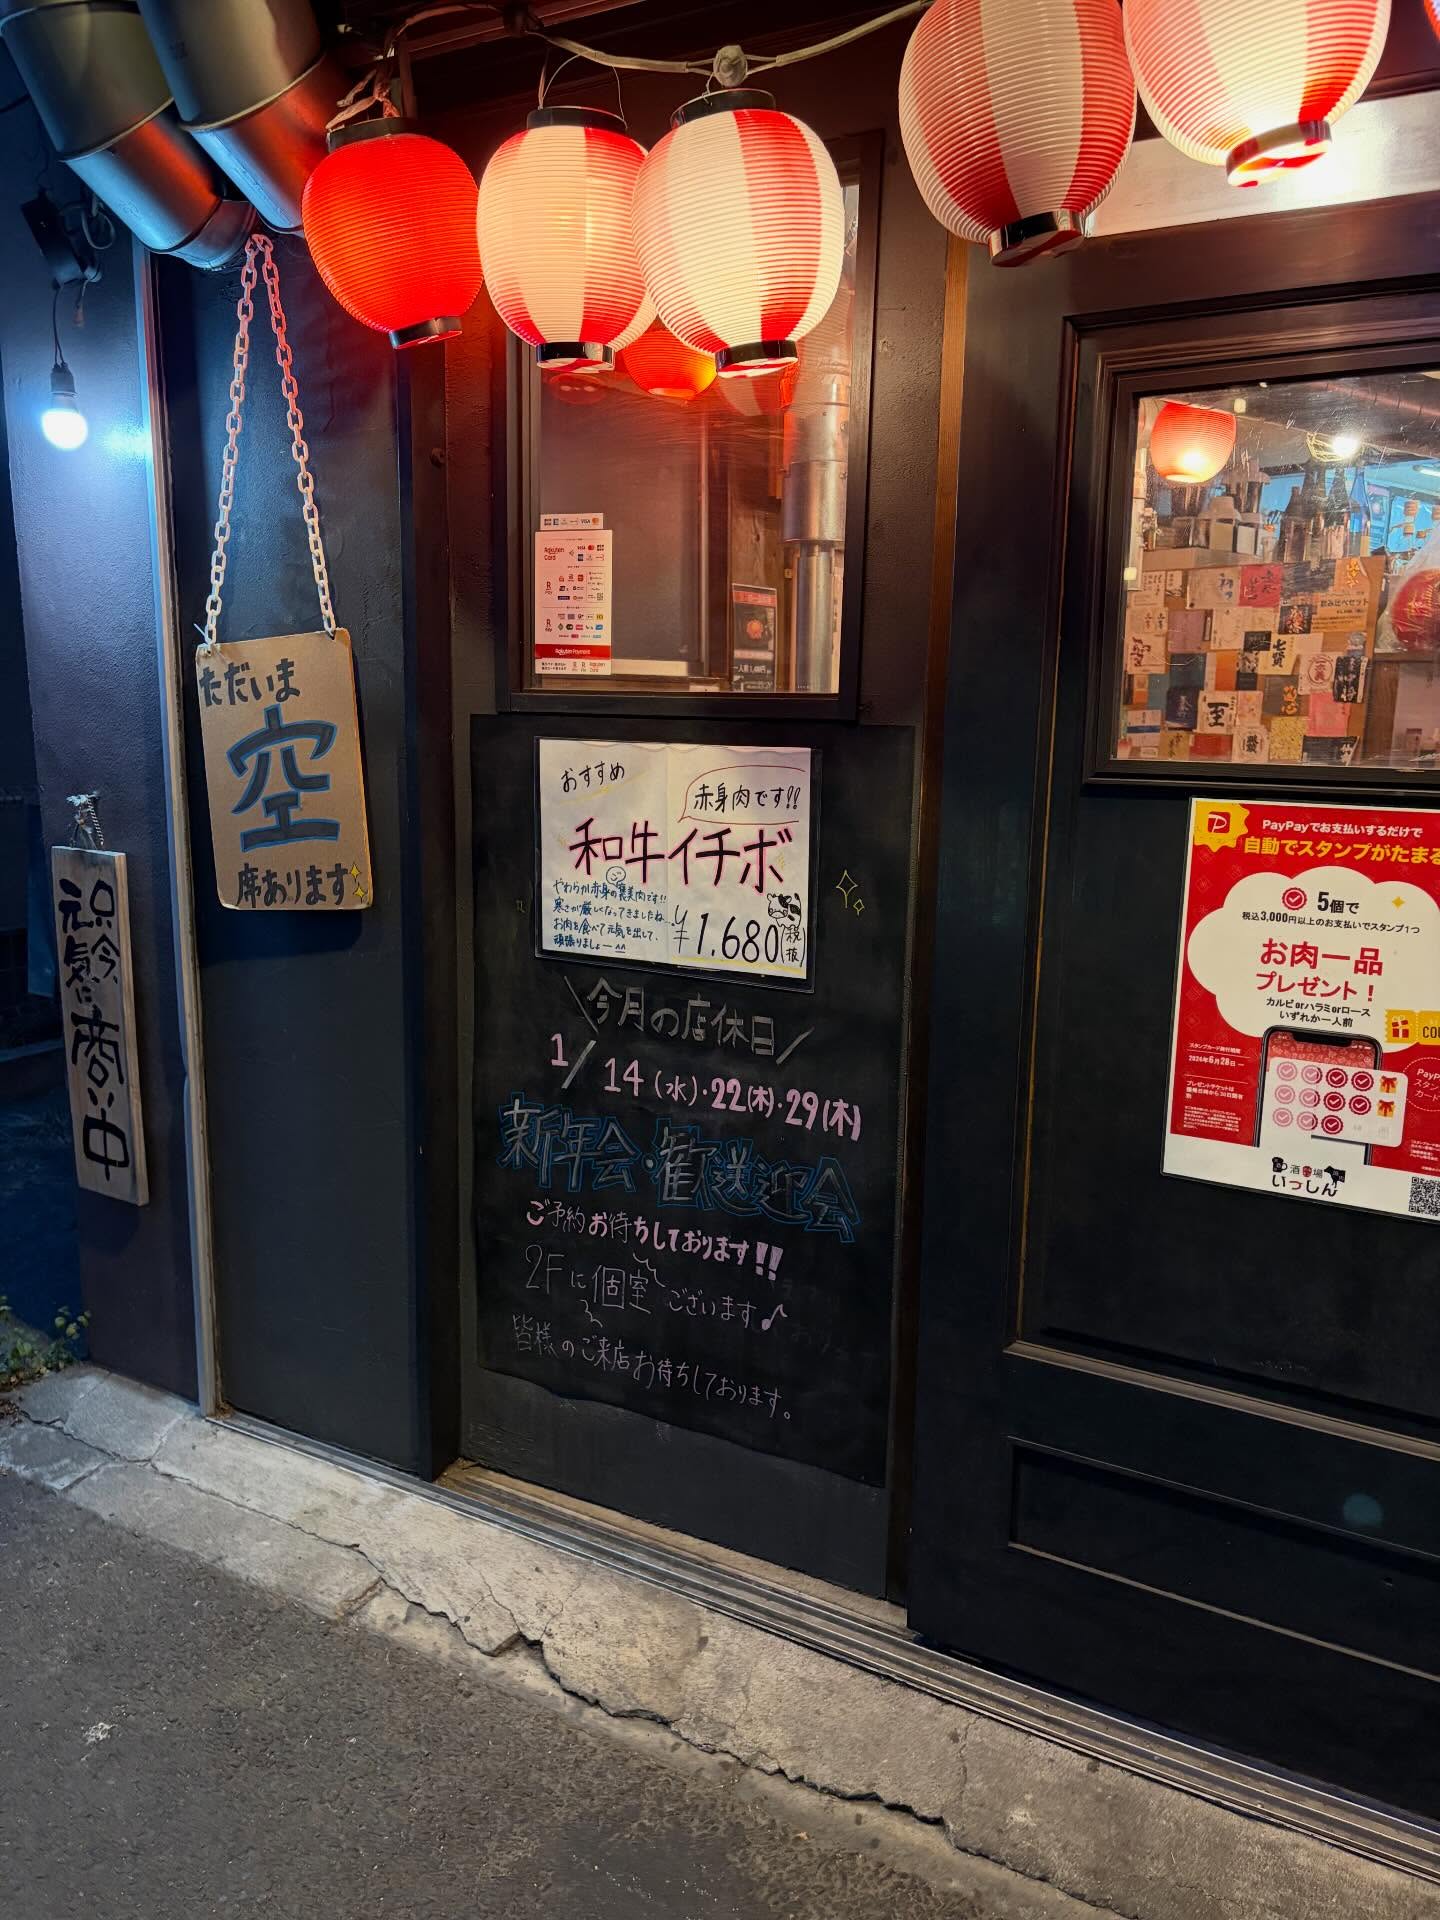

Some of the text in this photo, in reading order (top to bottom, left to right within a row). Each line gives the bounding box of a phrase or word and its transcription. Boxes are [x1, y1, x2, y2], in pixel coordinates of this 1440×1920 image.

[199, 658, 301, 708] ただいま
[226, 703, 341, 853] 空
[560, 760, 626, 793] おすすめ
[1262, 819, 1424, 839] PayPayでお支払いするだけで
[569, 817, 793, 894] 和牛イチボ
[236, 862, 349, 909] 席あります
[1317, 890, 1360, 915] 5個で
[1260, 938, 1384, 976] お肉一品
[1256, 971, 1375, 1002] プレゼント！
[586, 977, 776, 1056] 今月の店休日
[1279, 1010, 1354, 1028] いずれか一人前
[1271, 1174, 1339, 1197] いっしん
